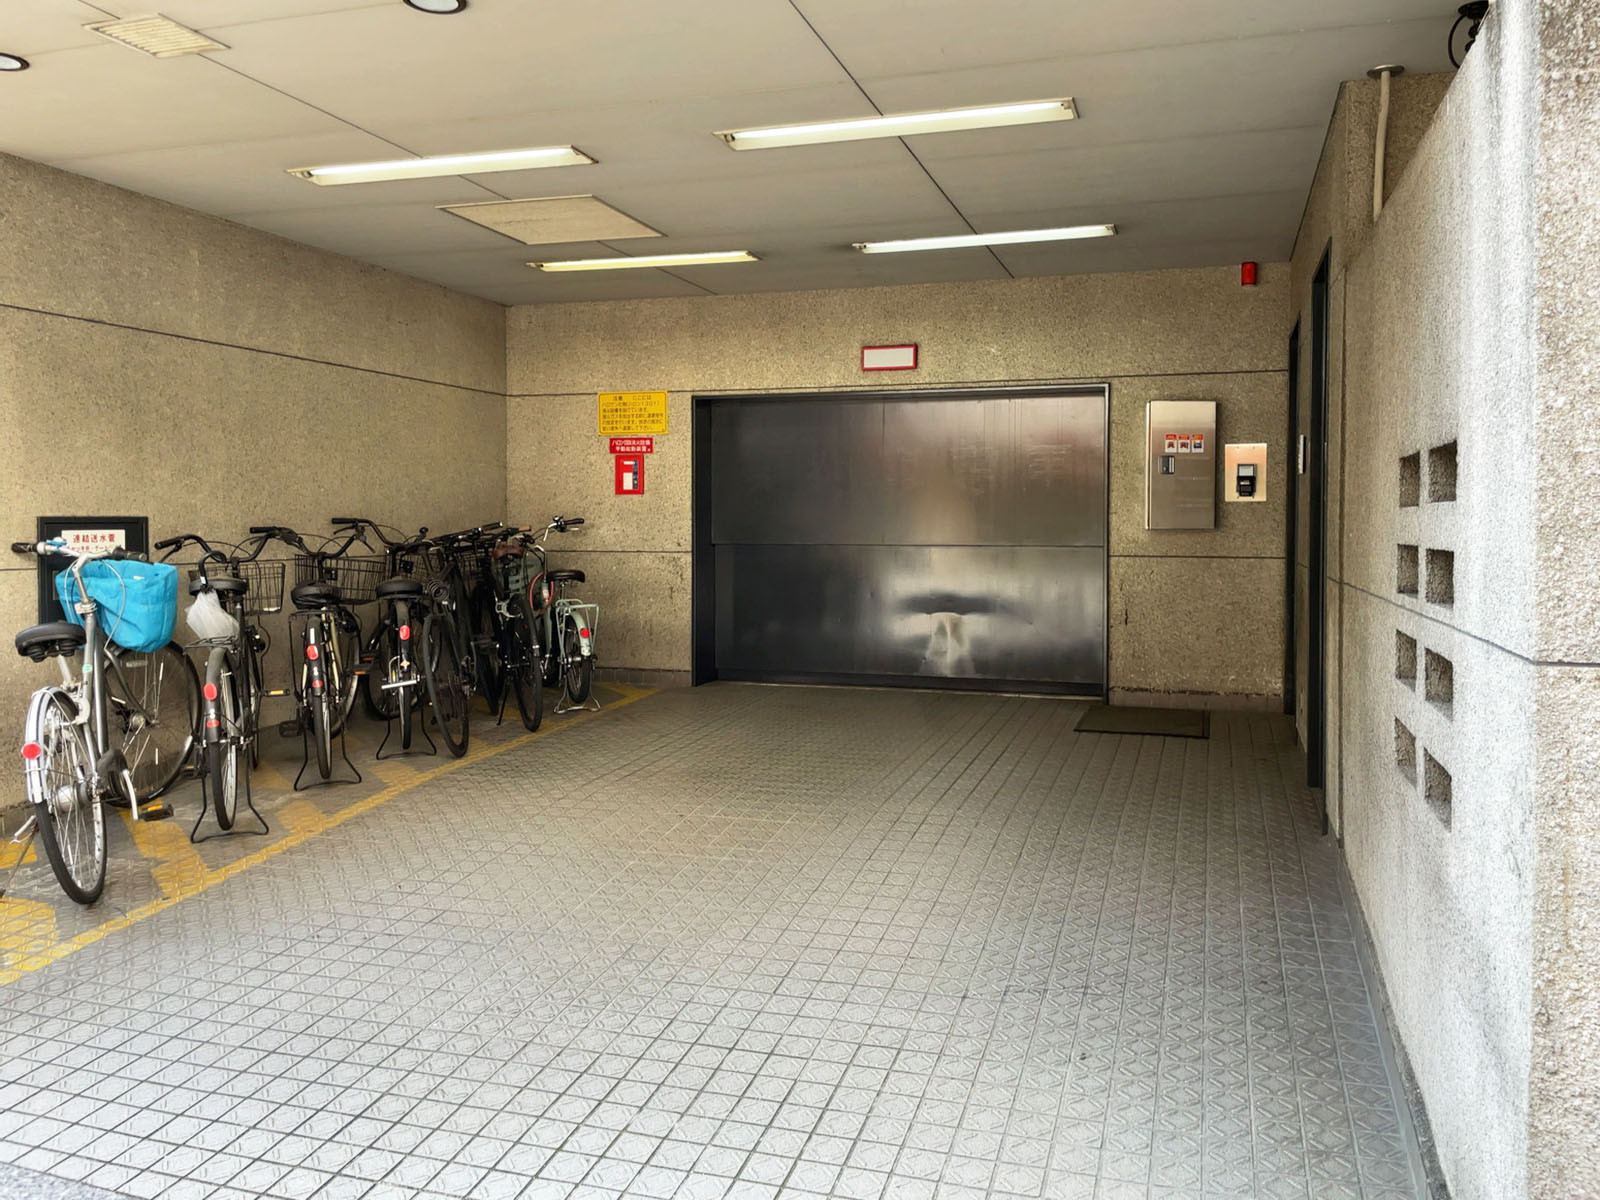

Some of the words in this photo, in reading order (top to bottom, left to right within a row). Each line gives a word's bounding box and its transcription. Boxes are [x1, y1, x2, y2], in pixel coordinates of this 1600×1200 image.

[73, 533, 115, 543] 連結送水管
